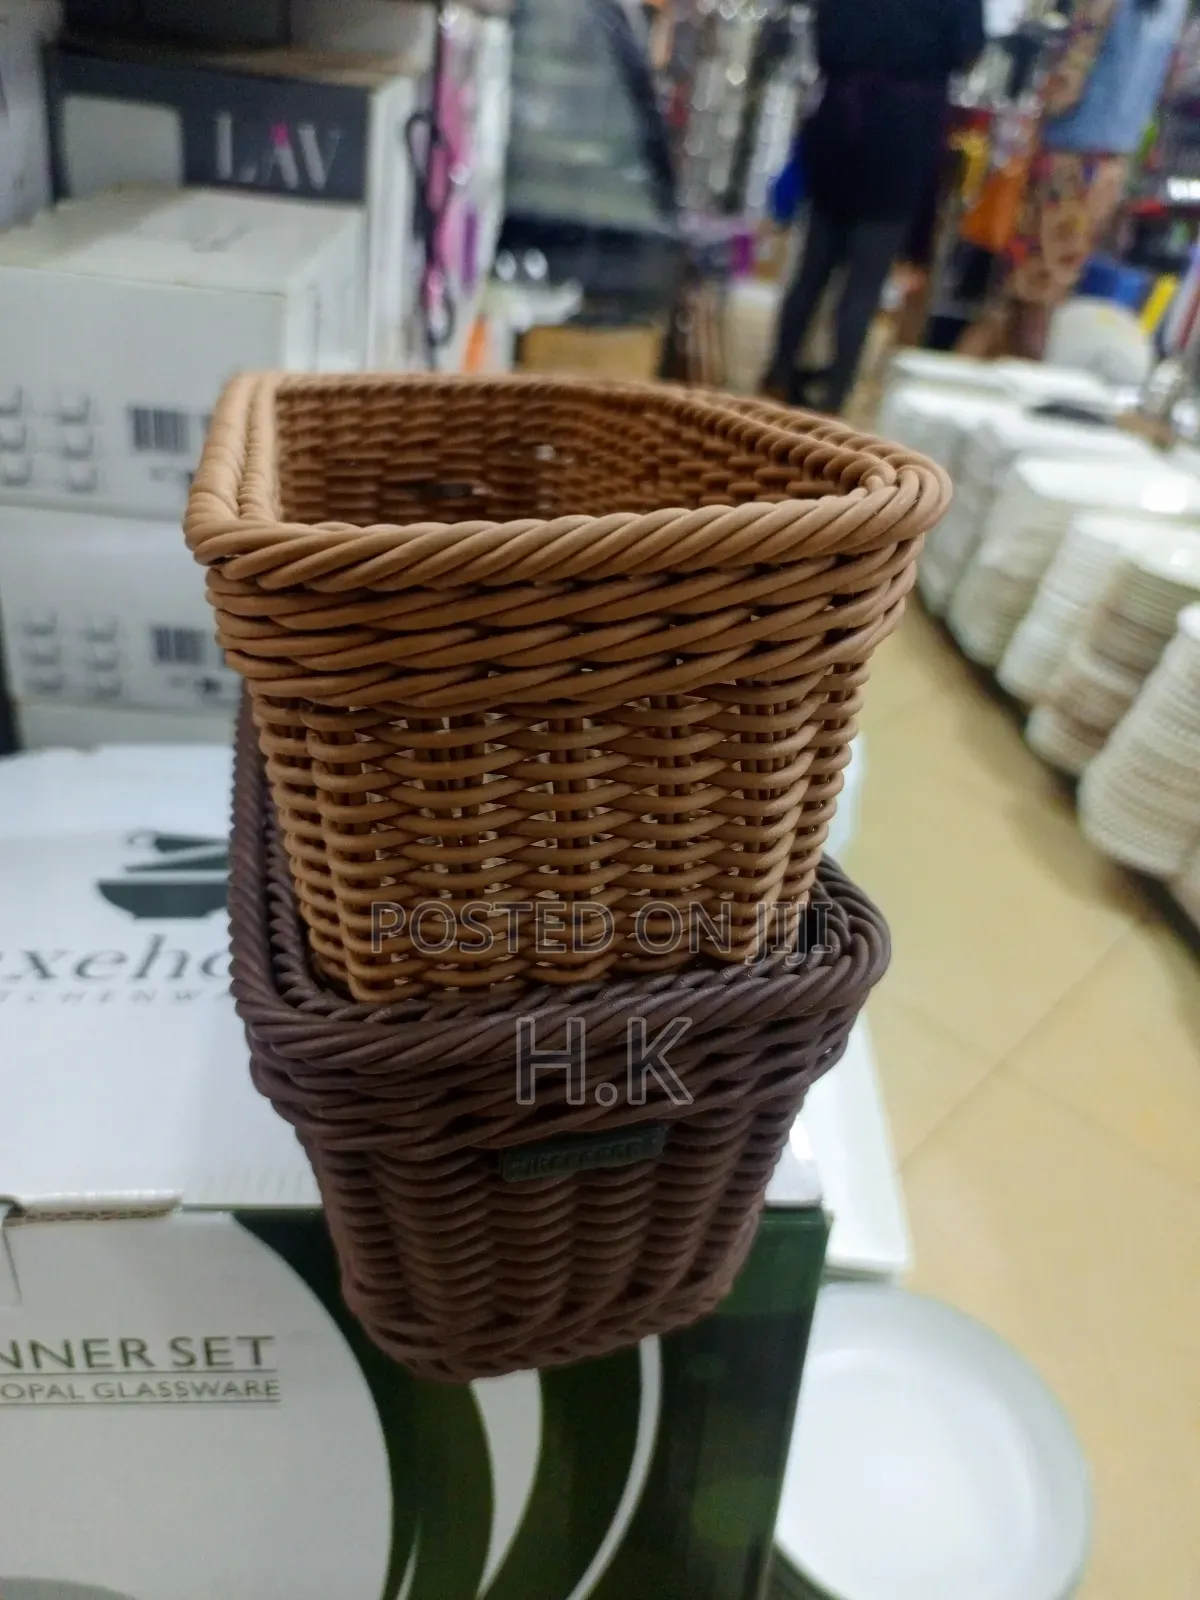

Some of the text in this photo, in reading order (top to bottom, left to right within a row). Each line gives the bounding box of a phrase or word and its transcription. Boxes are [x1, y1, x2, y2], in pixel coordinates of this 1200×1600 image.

[213, 111, 342, 191] LAV
[168, 1335, 275, 1367] SET
[0, 1378, 281, 1400] OPAL GLASSWARE
